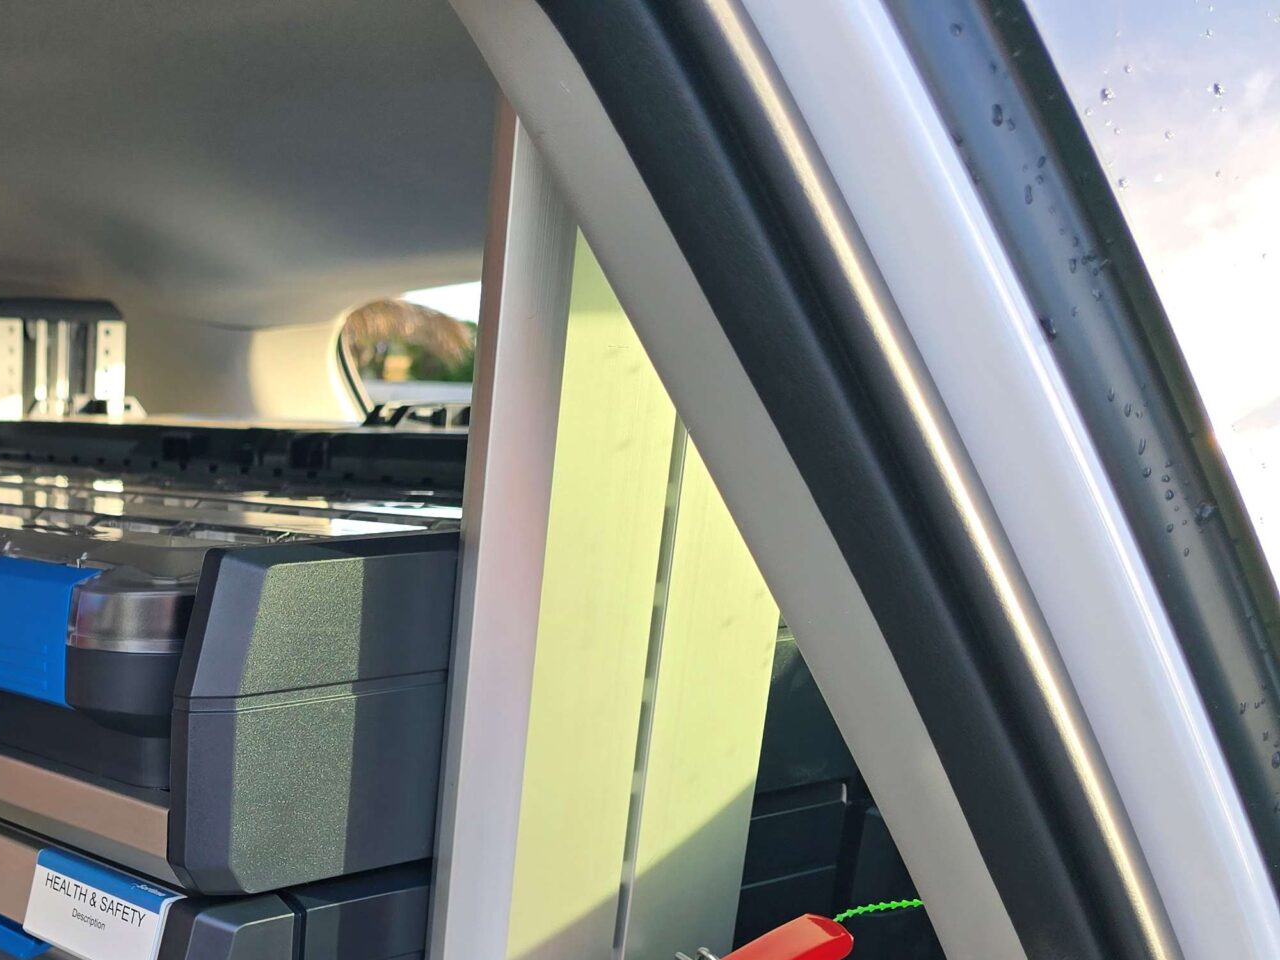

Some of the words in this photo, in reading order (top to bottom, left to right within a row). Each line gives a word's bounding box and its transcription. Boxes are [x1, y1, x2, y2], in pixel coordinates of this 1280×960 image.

[45, 872, 88, 903] HEALTH
[90, 892, 97, 908] &
[100, 896, 146, 928] SAFETY
[71, 908, 106, 931] Description
